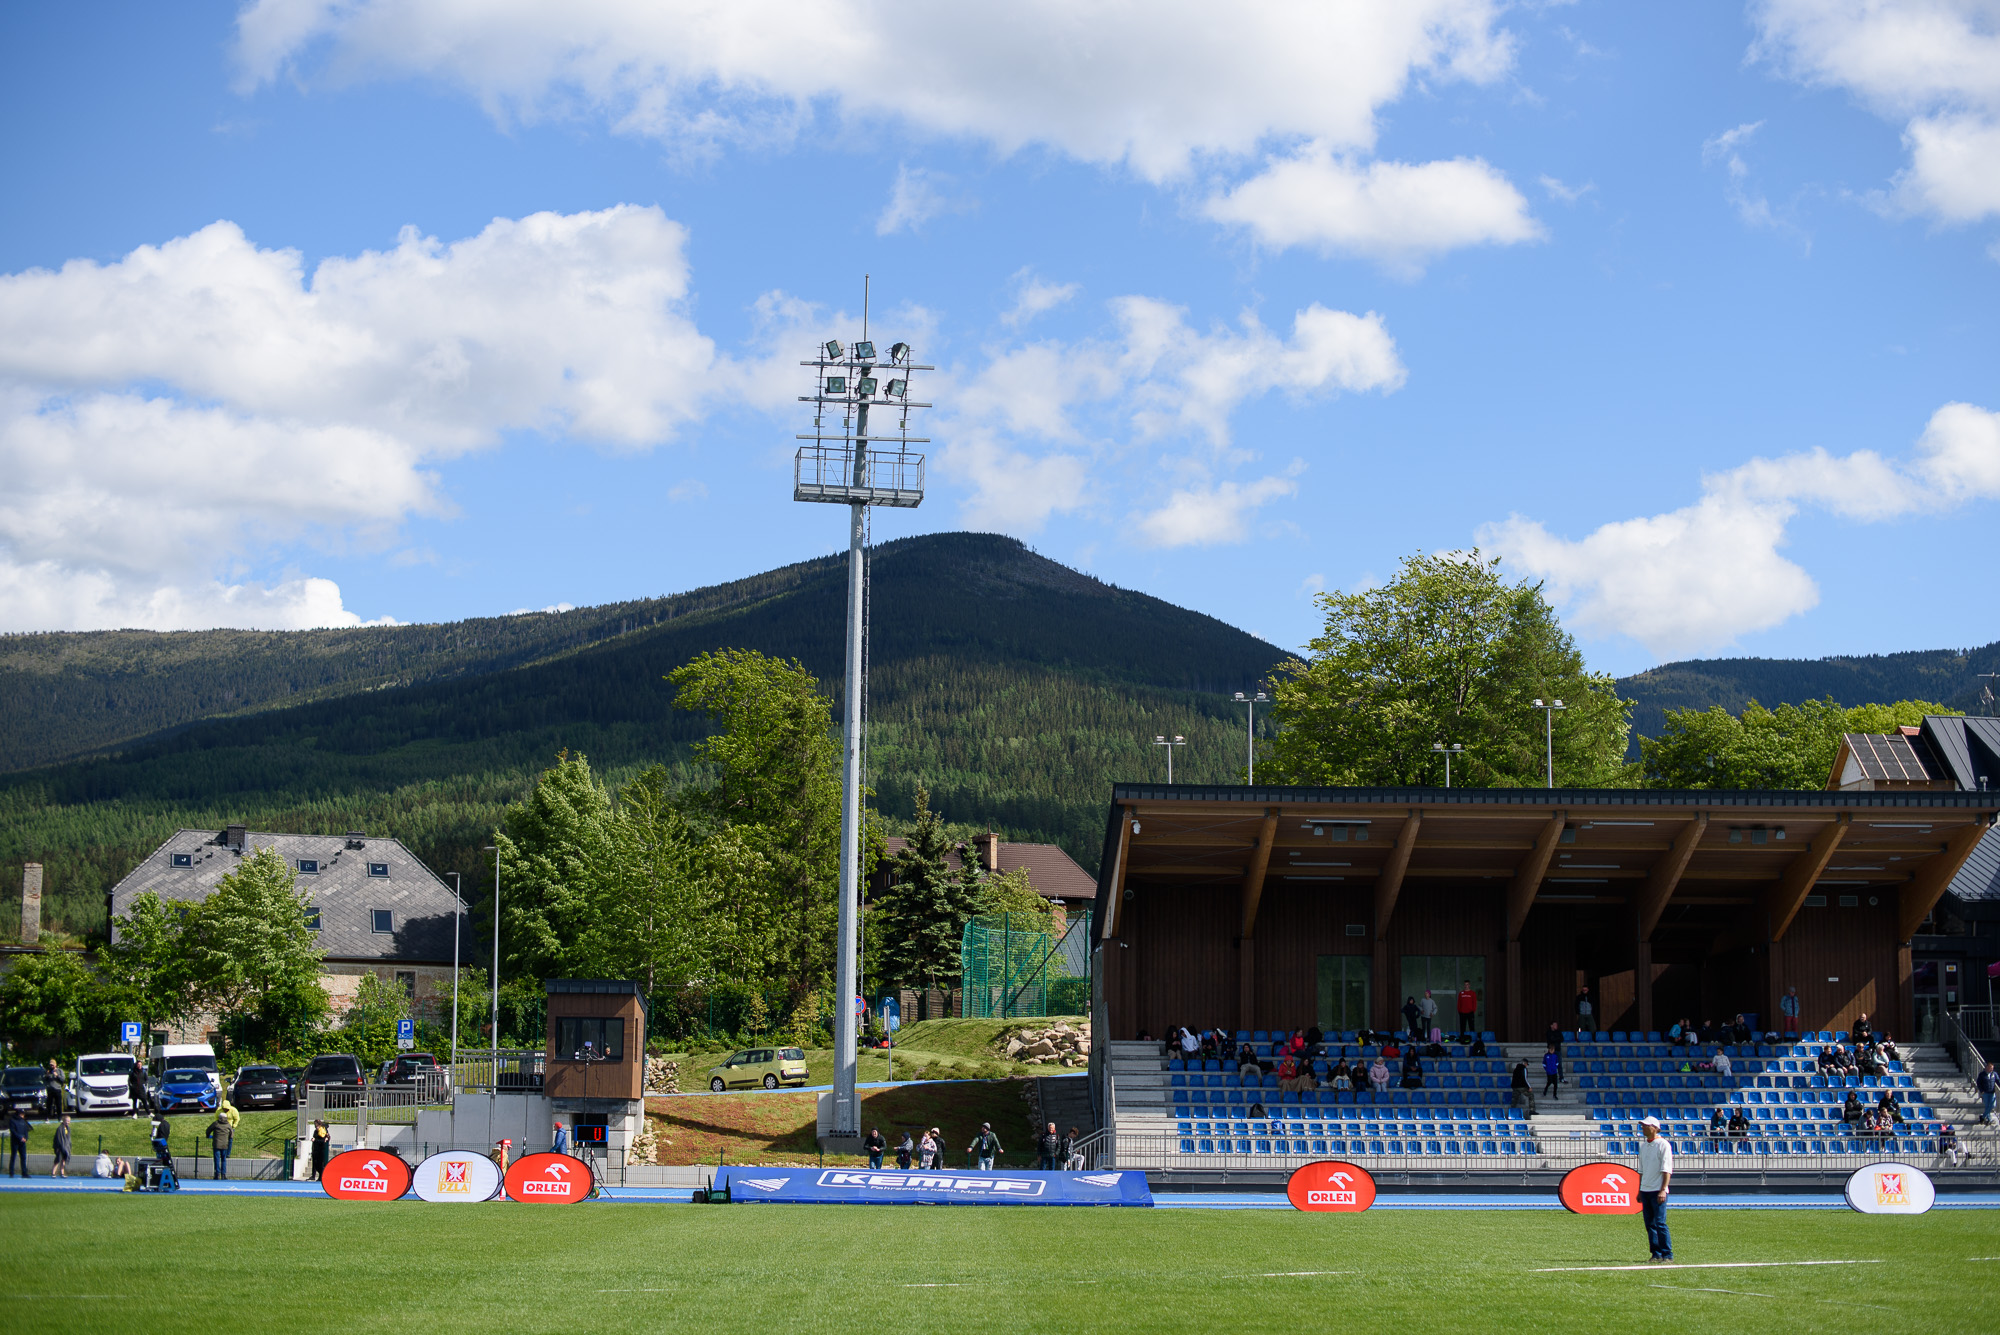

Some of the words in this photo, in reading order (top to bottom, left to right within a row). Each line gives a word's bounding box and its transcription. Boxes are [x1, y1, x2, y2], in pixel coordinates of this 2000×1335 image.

[126, 1024, 137, 1039] P
[401, 1021, 411, 1034] P
[343, 1179, 384, 1190] ORLEN
[831, 1173, 1031, 1191] KEMPF
[439, 1183, 468, 1192] PZLA
[526, 1183, 567, 1192] ORLEN
[1311, 1192, 1352, 1202] ORLEN
[1585, 1194, 1627, 1204] ORLEN
[1879, 1195, 1908, 1203] PZLA
